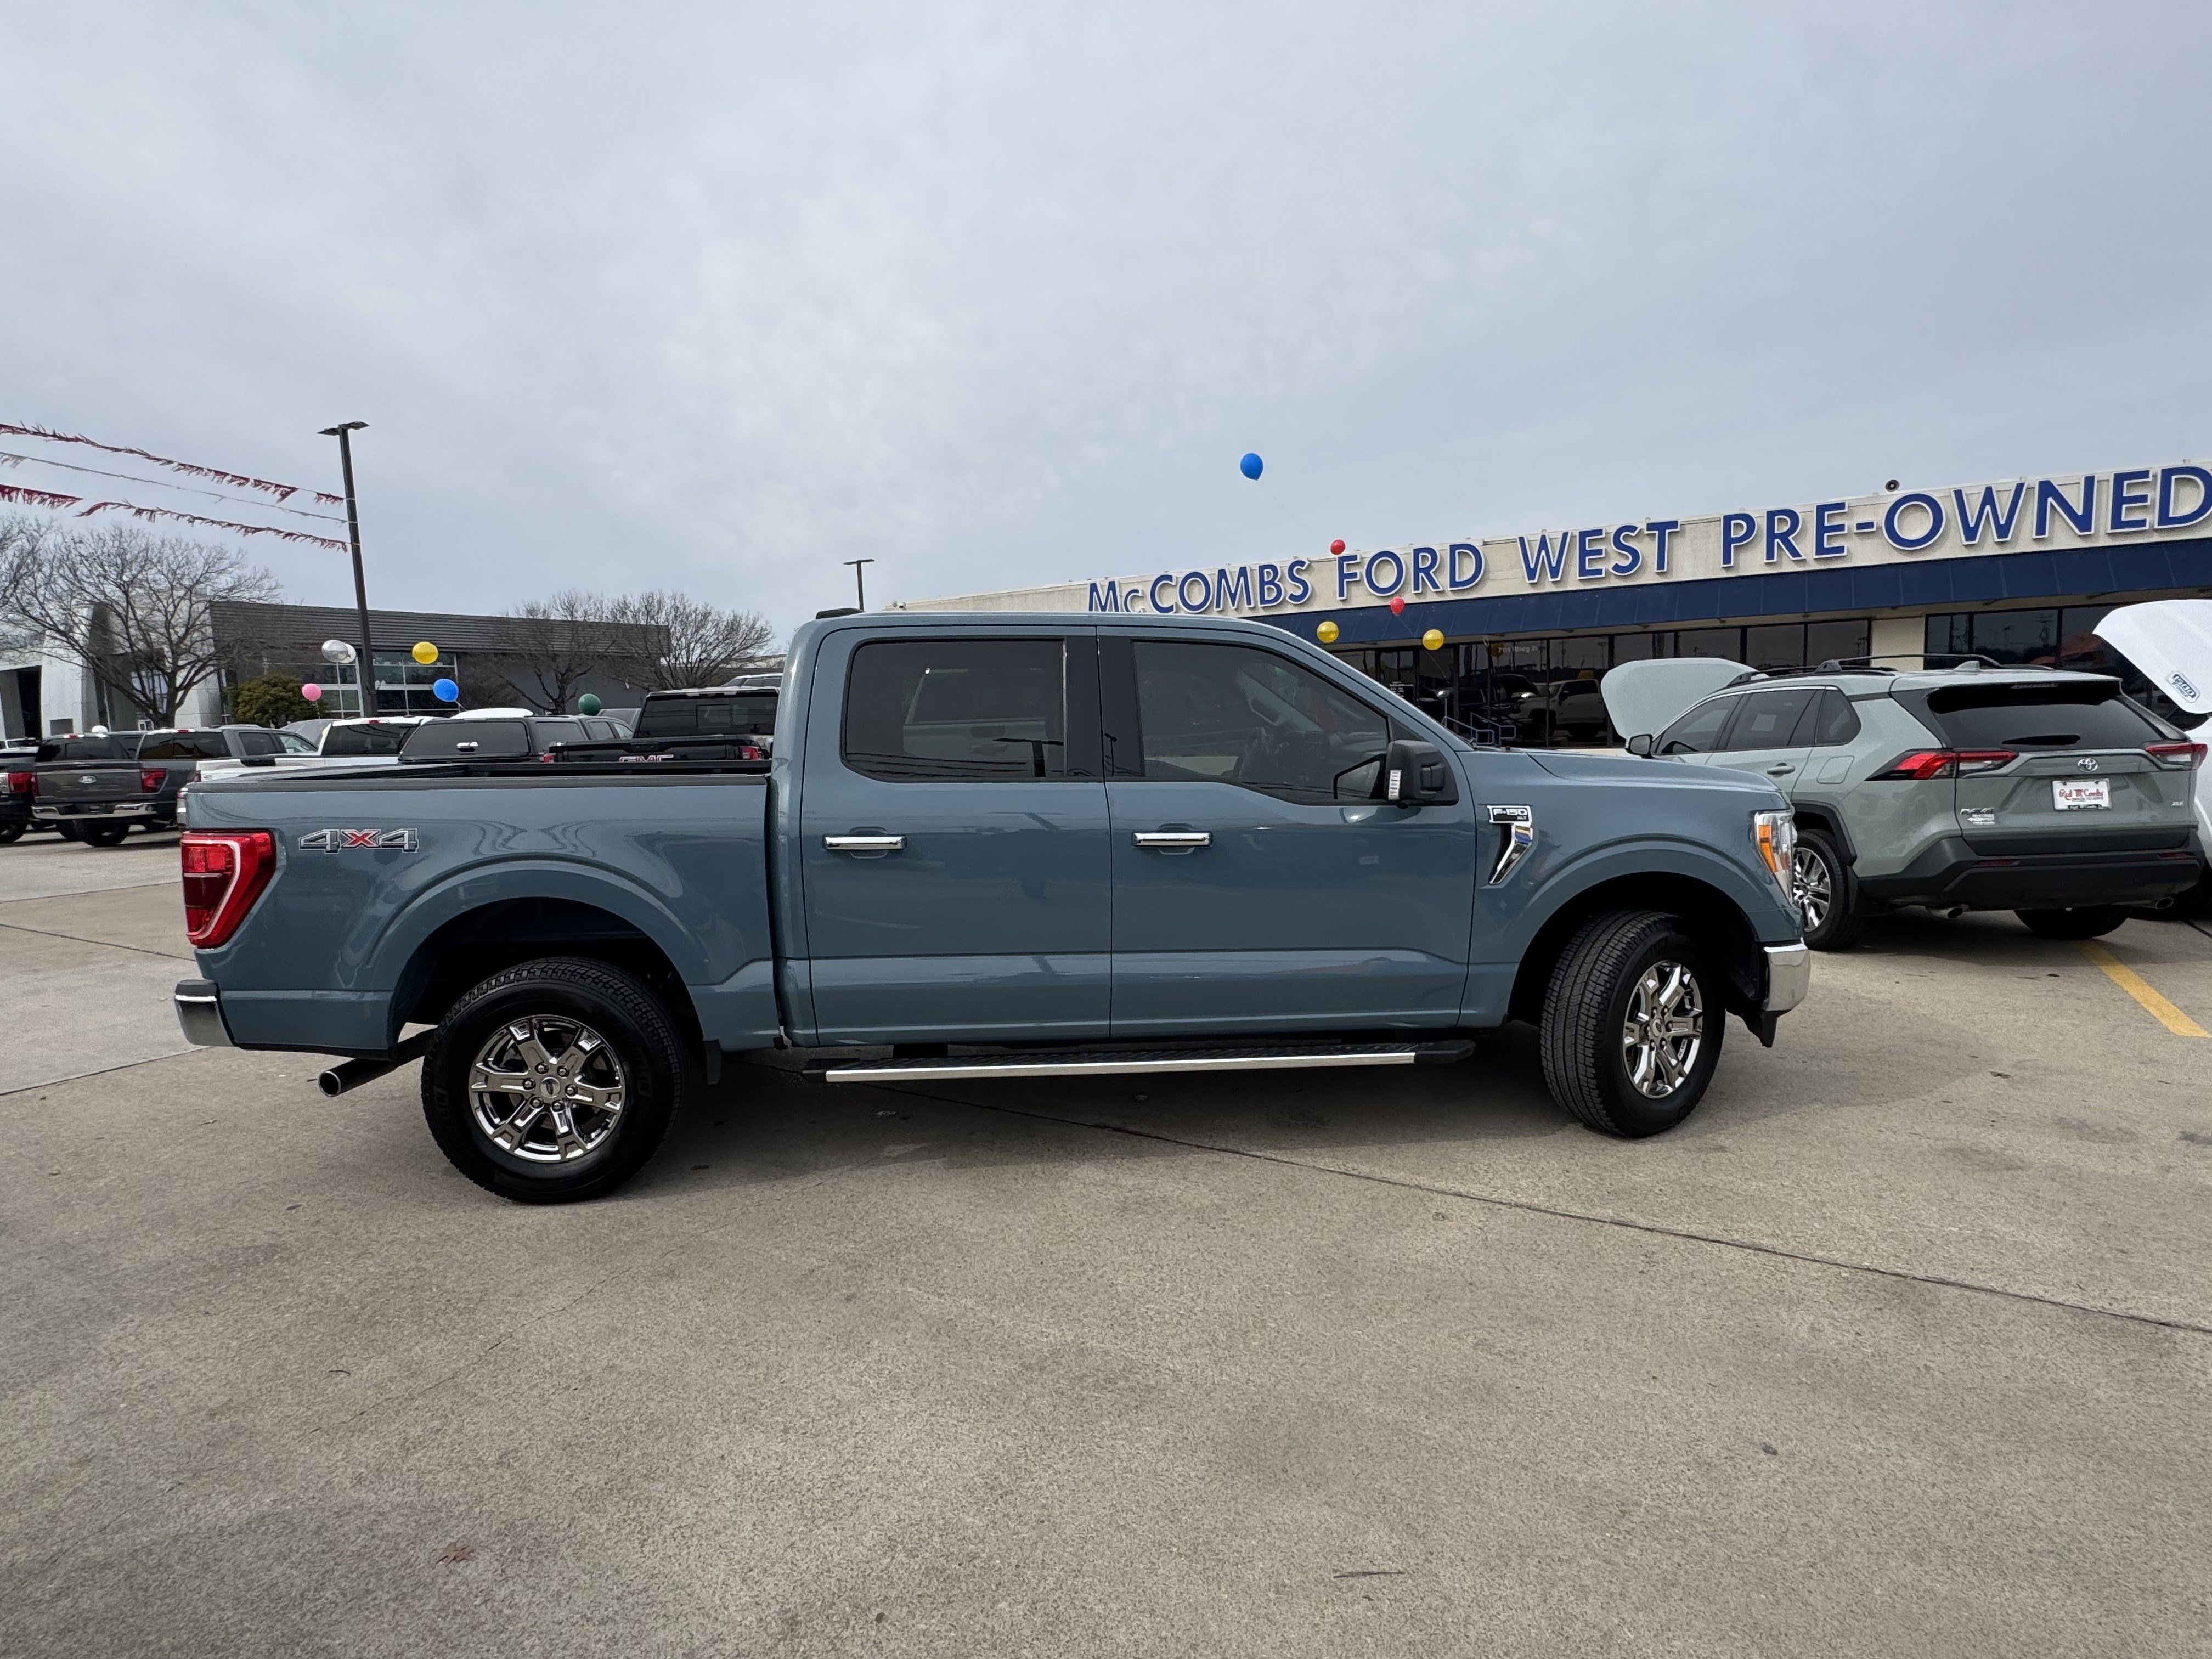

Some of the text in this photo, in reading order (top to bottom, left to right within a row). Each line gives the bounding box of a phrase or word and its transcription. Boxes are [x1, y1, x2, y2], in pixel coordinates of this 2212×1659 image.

[1336, 542, 1485, 601] FORD
[1517, 519, 1680, 583] WEST
[1720, 465, 2212, 568] PRE-OWNED
